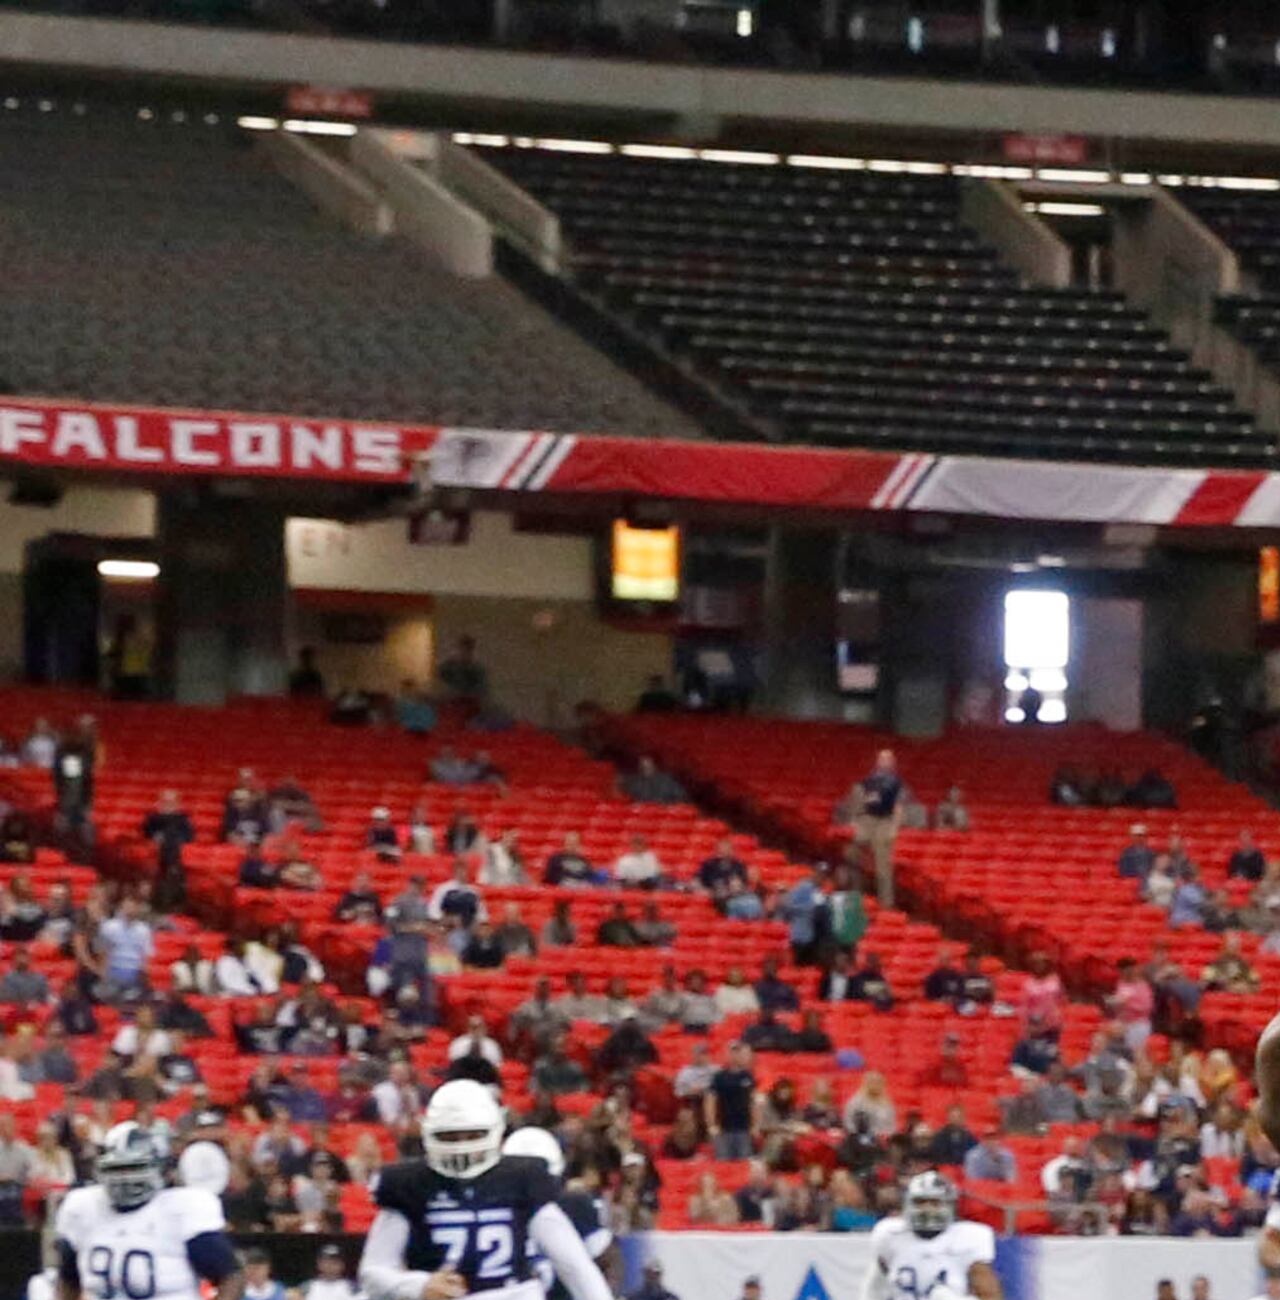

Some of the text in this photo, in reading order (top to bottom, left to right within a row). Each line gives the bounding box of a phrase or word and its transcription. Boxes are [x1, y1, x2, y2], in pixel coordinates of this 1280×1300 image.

[0, 408, 400, 473] FALCONS
[89, 1246, 156, 1300] 90
[430, 1224, 515, 1280] 72
